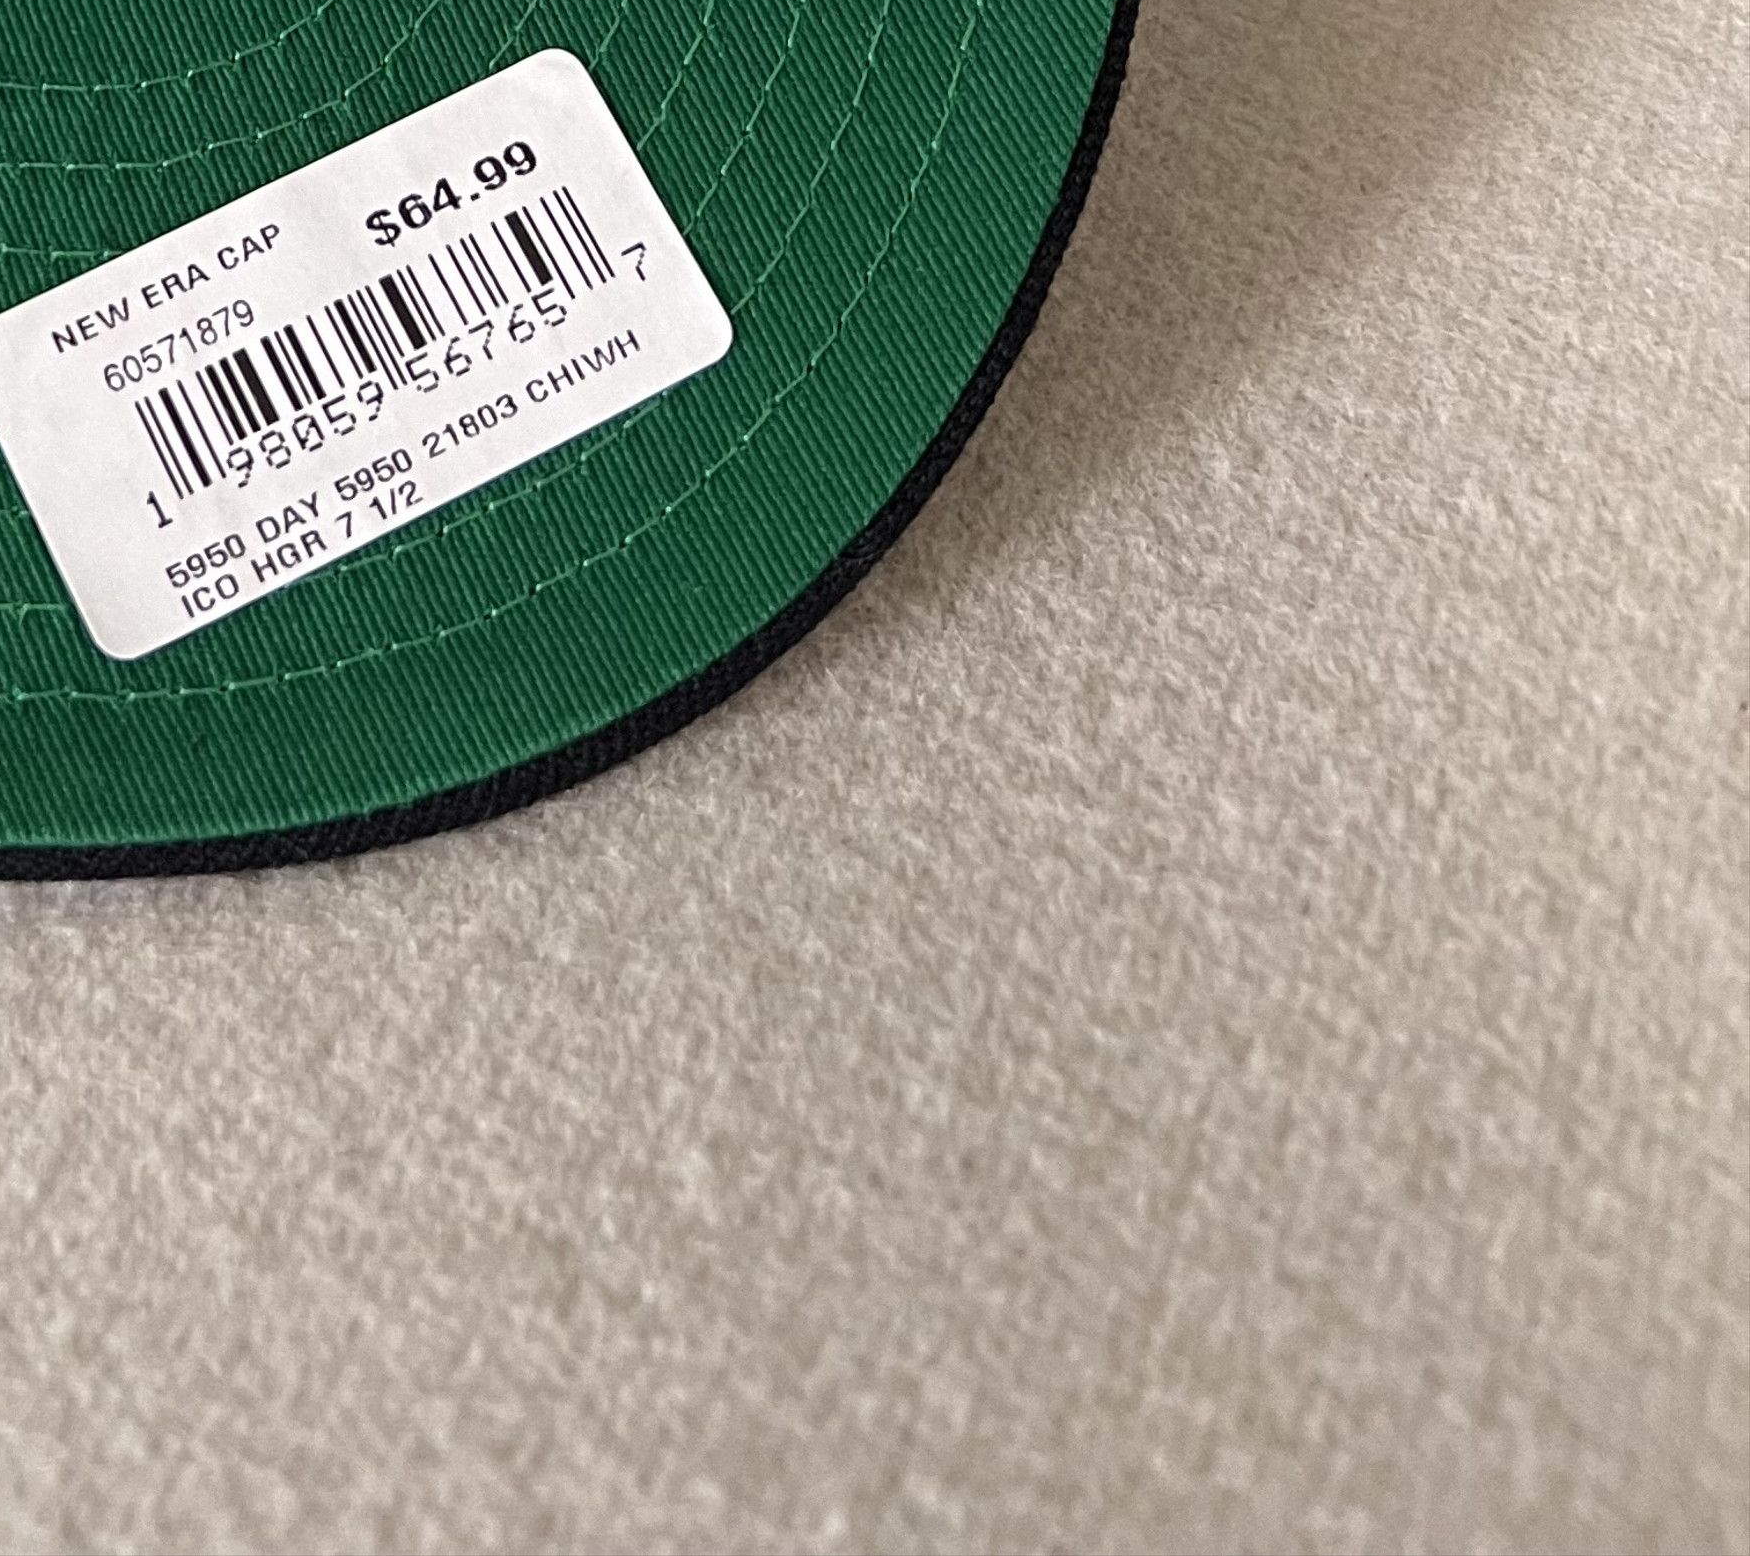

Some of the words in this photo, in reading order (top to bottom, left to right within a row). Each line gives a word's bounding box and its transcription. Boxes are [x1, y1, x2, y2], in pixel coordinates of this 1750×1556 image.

[365, 141, 537, 248] $64.99
[52, 297, 129, 353] NEW
[141, 264, 211, 309] ERA
[217, 224, 280, 270] CAP
[103, 299, 254, 392] 60571879
[165, 534, 246, 588] 5950
[255, 492, 319, 543] DAY
[334, 449, 413, 501] 5950
[422, 394, 518, 458] 21803
[525, 330, 639, 403] CHIWH
[181, 574, 239, 618] ICO
[250, 530, 327, 583] HGR
[336, 511, 352, 538] 7
[369, 480, 422, 520] 1/2
